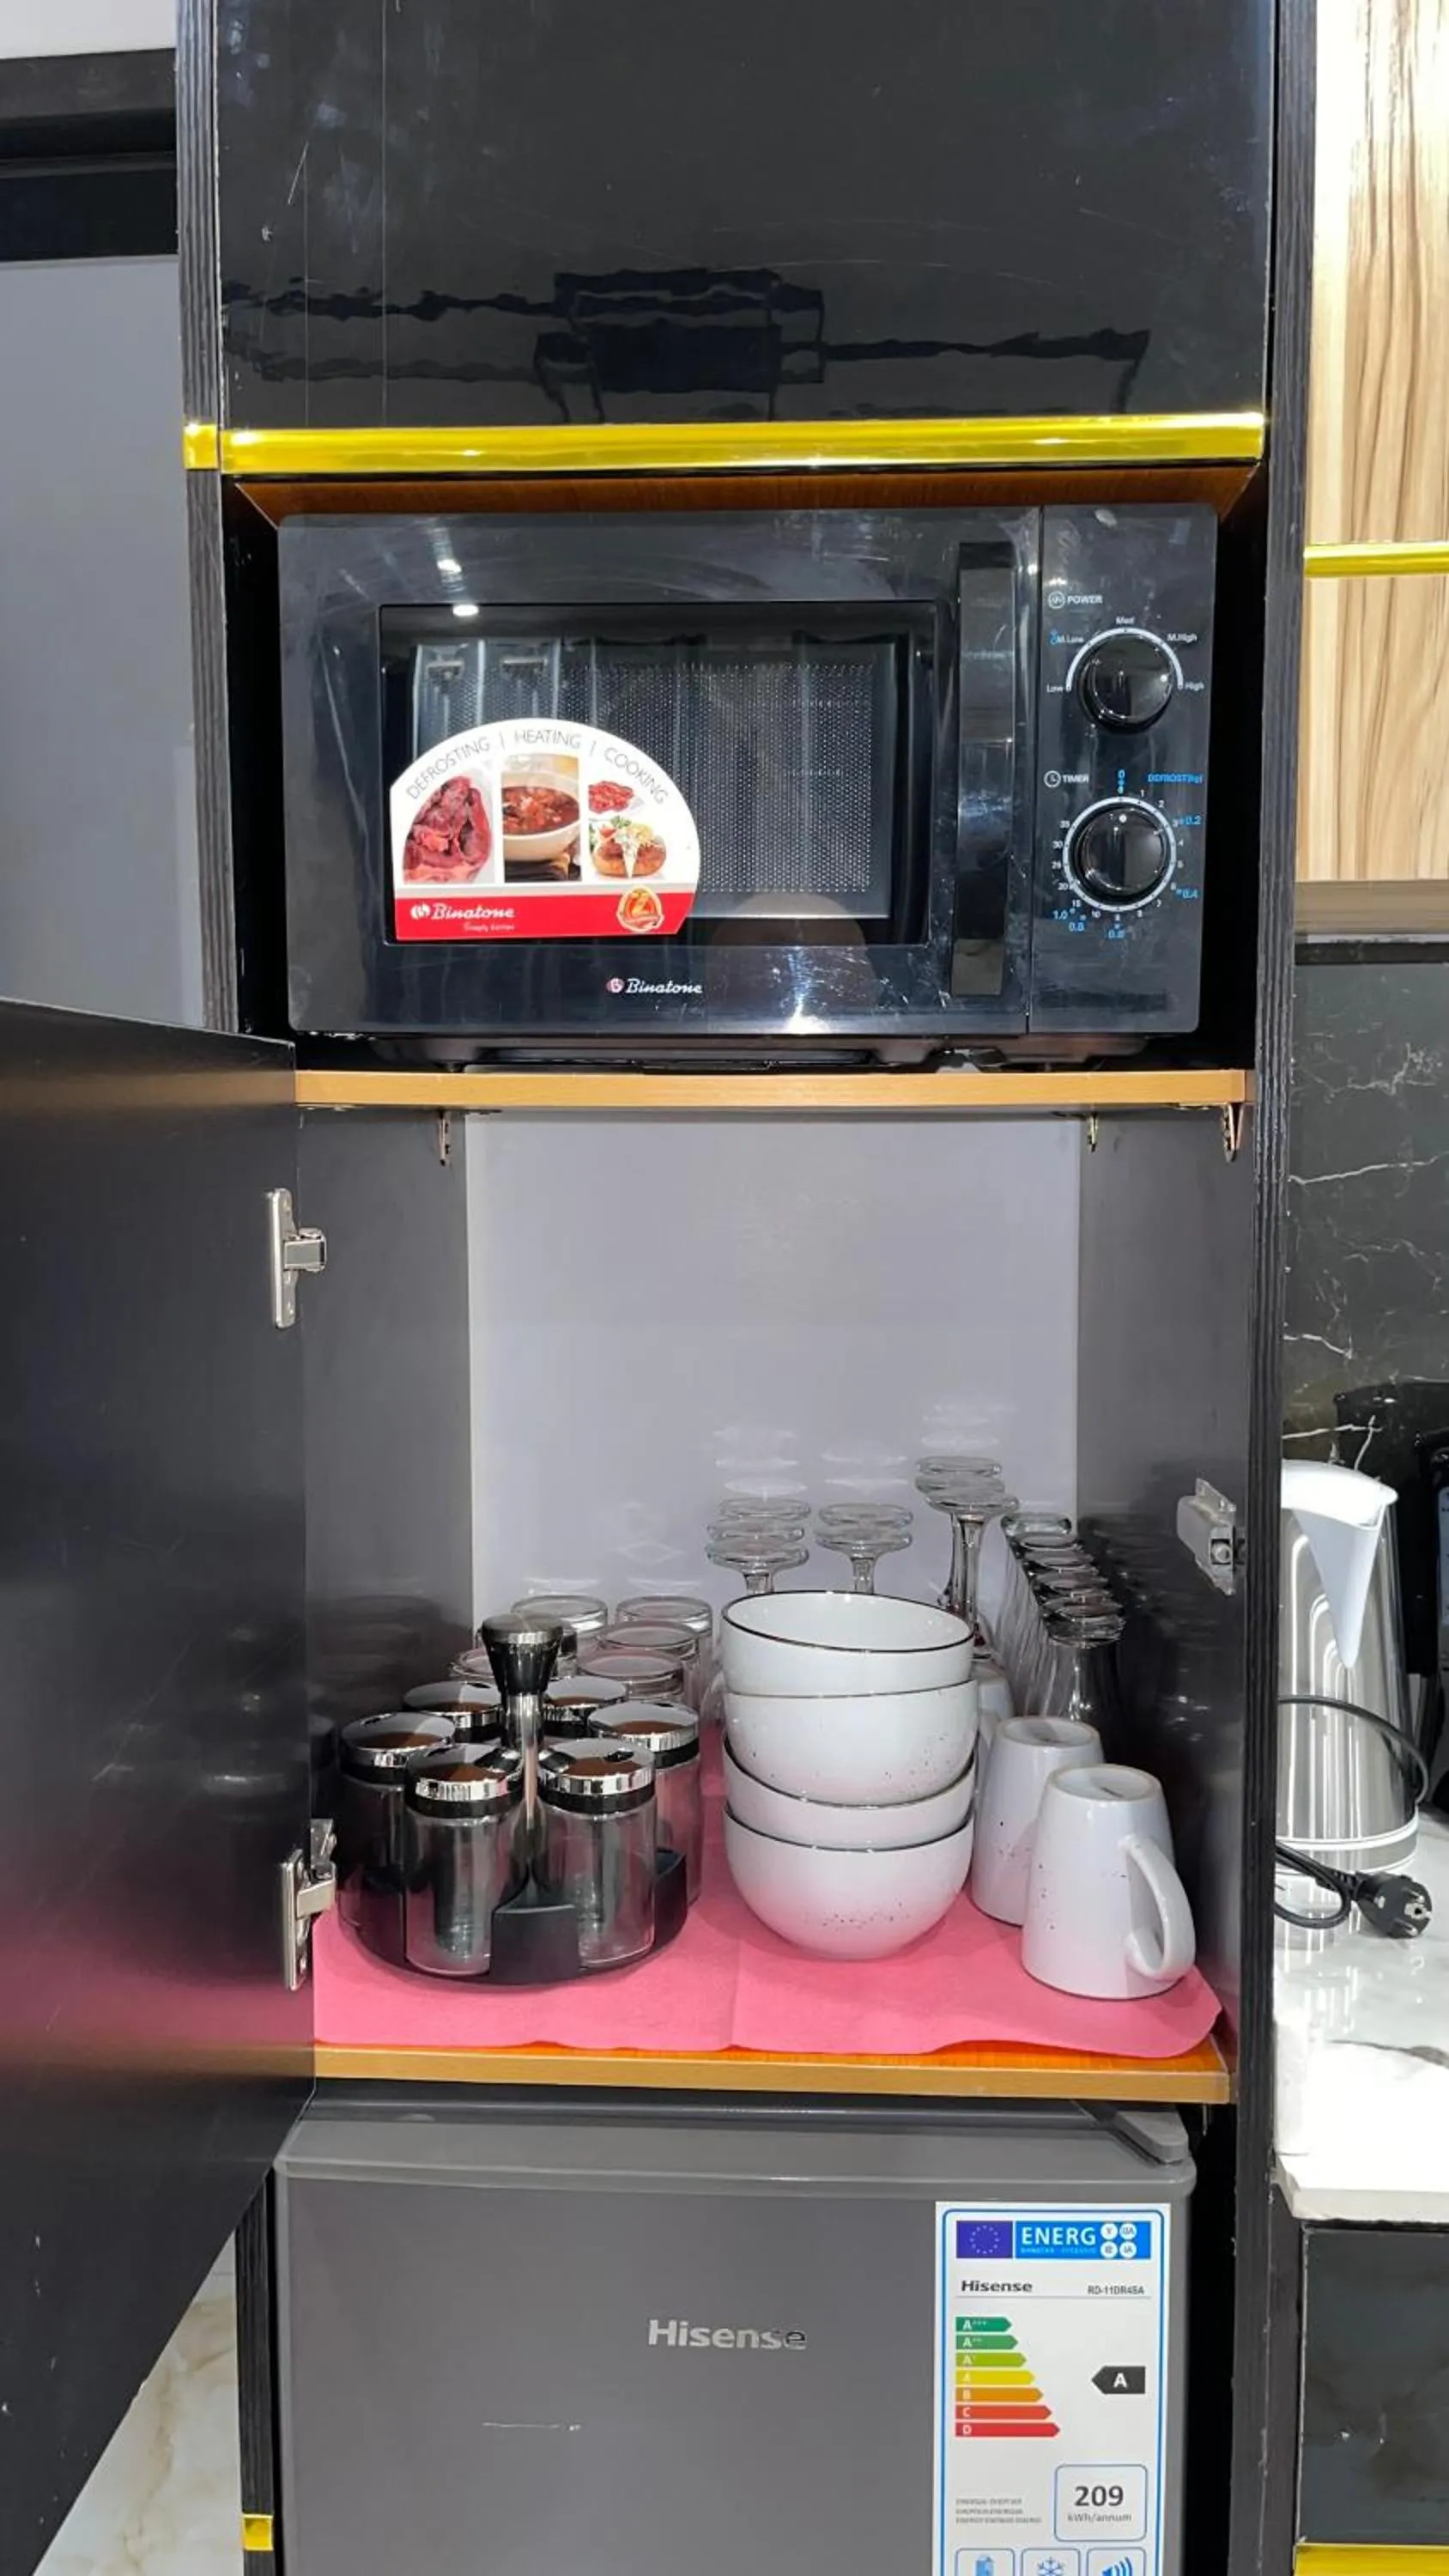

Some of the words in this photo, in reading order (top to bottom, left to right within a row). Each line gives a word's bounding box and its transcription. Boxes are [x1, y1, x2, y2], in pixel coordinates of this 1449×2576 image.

[1067, 594, 1103, 605] POWER
[1167, 634, 1197, 644] M.High
[1185, 681, 1205, 692] High
[405, 735, 490, 800] DEFROSTING
[514, 729, 582, 750] HEATING
[603, 745, 668, 805] COOKING
[1062, 774, 1089, 784] TIMER
[1185, 816, 1201, 824] 0.2
[431, 902, 516, 920] Binatone
[1052, 909, 1069, 920] 1.0
[626, 977, 704, 995] Binatone
[1022, 2227, 1096, 2245] ENERG
[961, 2280, 1033, 2293] Hisense
[648, 2318, 806, 2350] Hisense
[1113, 2372, 1128, 2388] A
[962, 2407, 971, 2417] C
[962, 2425, 972, 2434] D
[1074, 2485, 1125, 2507] 209
[1067, 2513, 1132, 2523] kWh/annum
